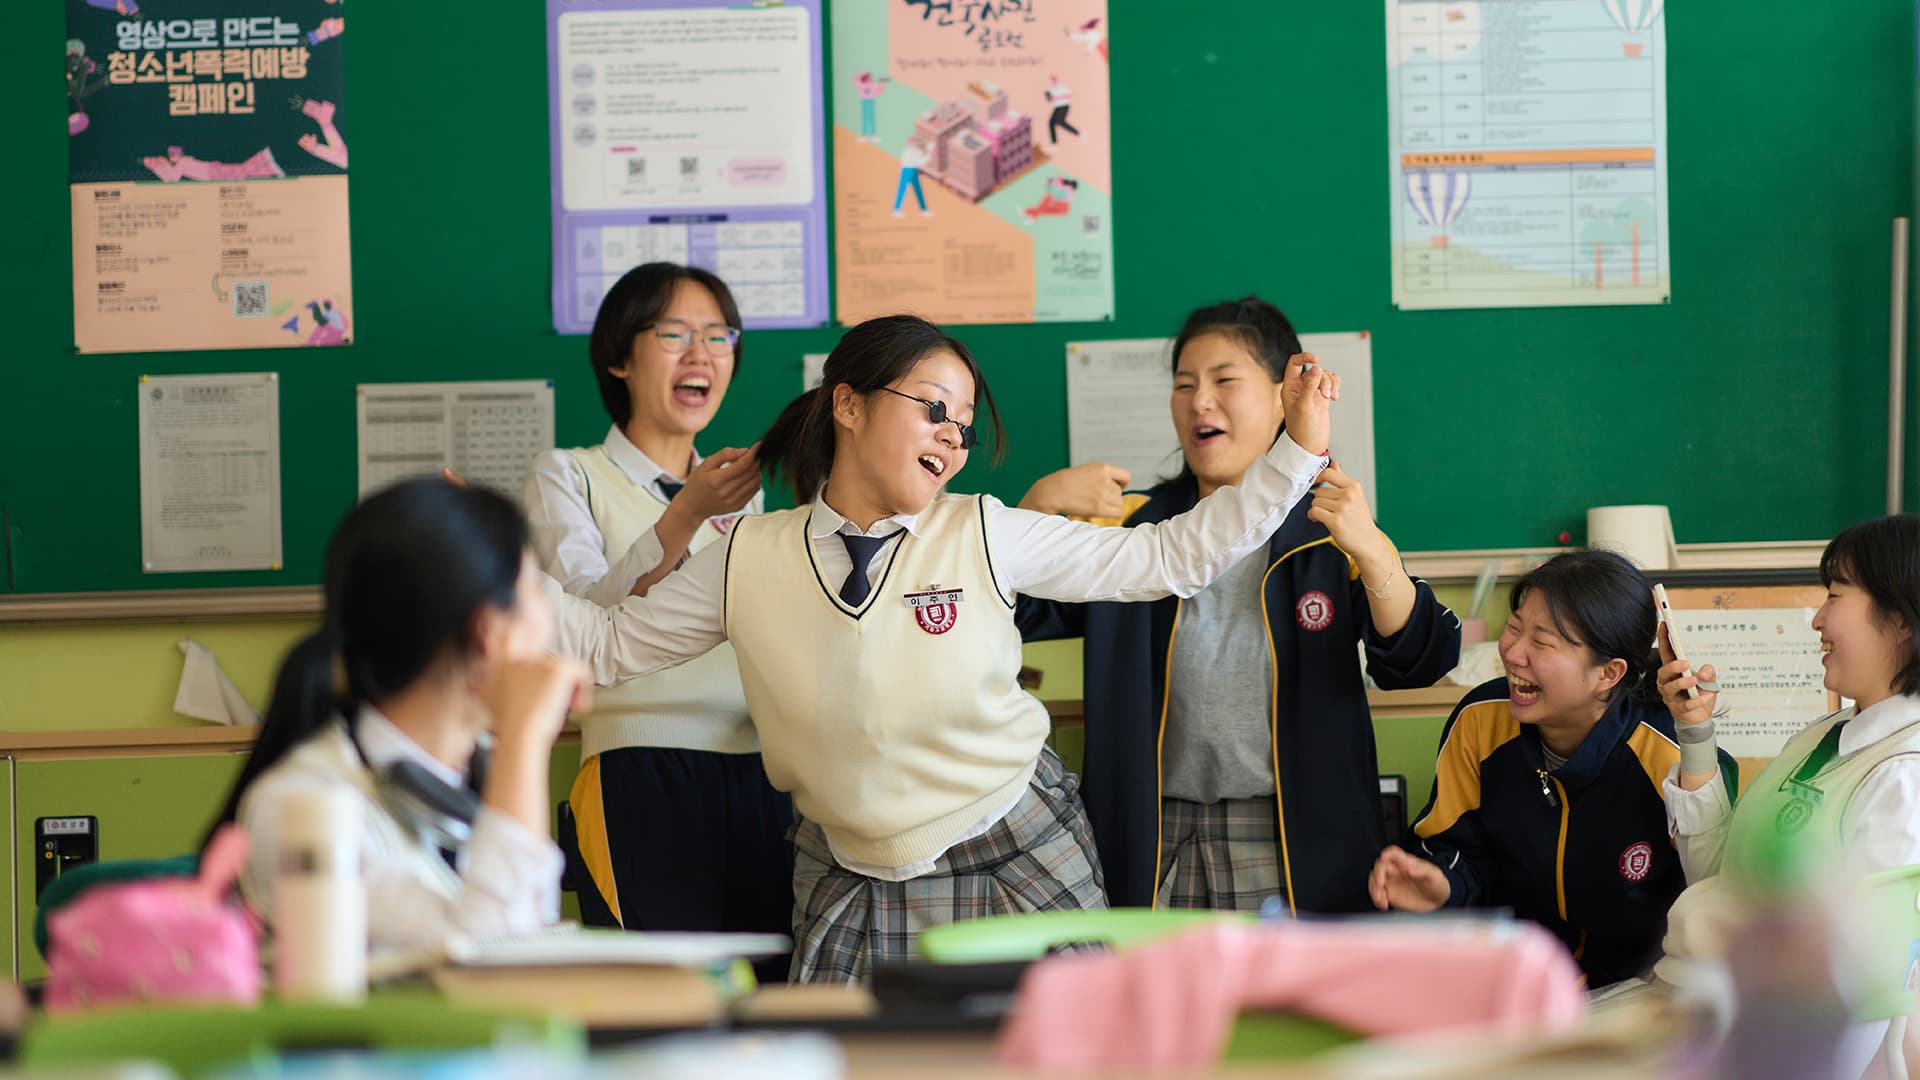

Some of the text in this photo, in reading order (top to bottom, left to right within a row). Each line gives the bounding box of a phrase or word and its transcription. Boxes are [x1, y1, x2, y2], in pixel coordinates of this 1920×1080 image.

[116, 16, 300, 50] 영상으로 만드는
[107, 47, 311, 84] 청소년폭력예방
[168, 82, 255, 116] 캠페인
